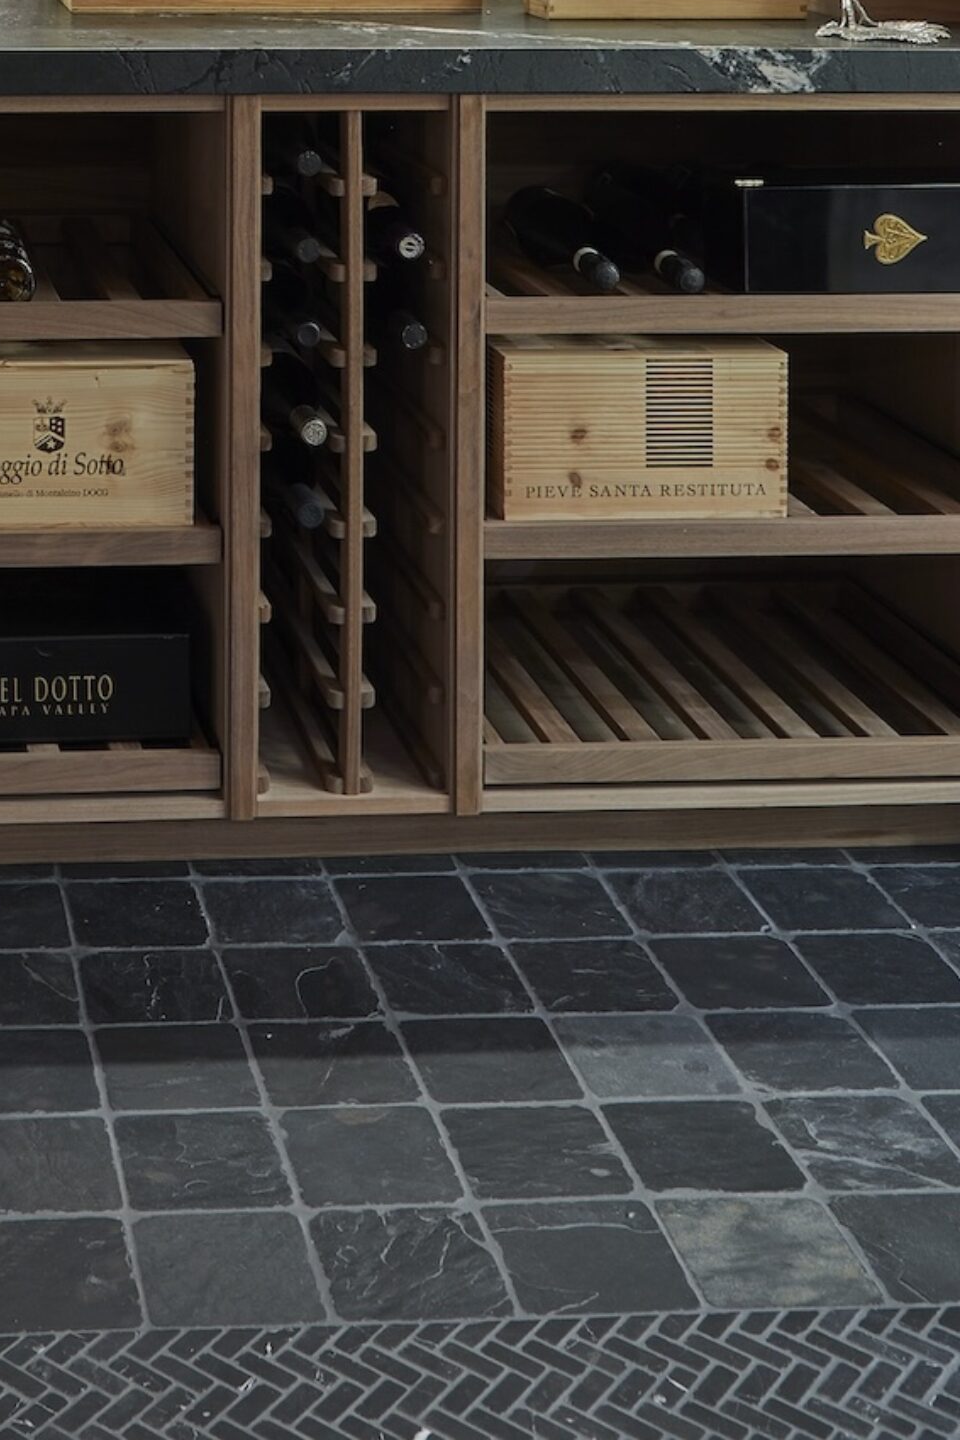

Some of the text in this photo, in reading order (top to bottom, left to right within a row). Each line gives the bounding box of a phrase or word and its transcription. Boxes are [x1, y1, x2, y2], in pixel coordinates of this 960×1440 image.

[48, 453, 68, 476] di
[73, 451, 124, 477] Sotto
[83, 488, 109, 497] DOCG
[524, 483, 767, 499] PIEVE SANTA RESTITUTA
[34, 674, 114, 703] DOTTO
[42, 703, 111, 716] VALLEY
